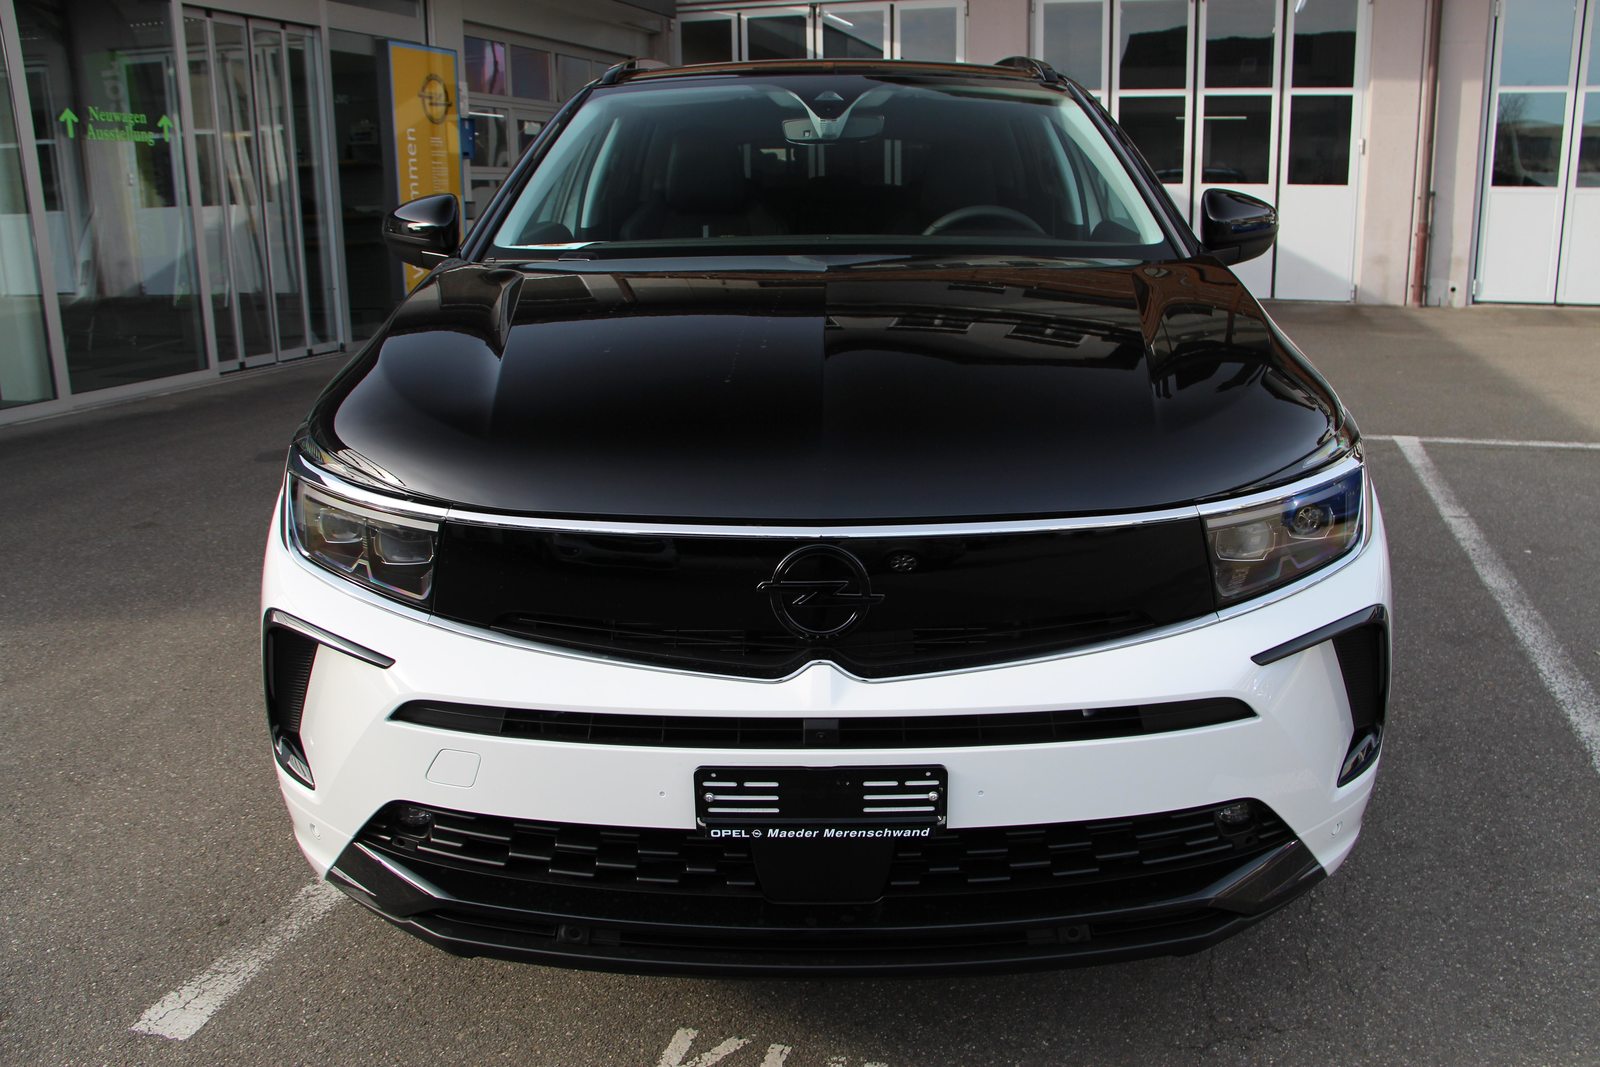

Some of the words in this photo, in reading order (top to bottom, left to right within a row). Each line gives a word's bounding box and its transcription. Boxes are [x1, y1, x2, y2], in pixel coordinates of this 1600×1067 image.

[88, 106, 147, 126] Neuwagen
[87, 123, 155, 146] Ausstellung
[710, 829, 750, 838] OPEL
[767, 828, 819, 838] Maeder
[823, 827, 930, 838] Merenschwand
